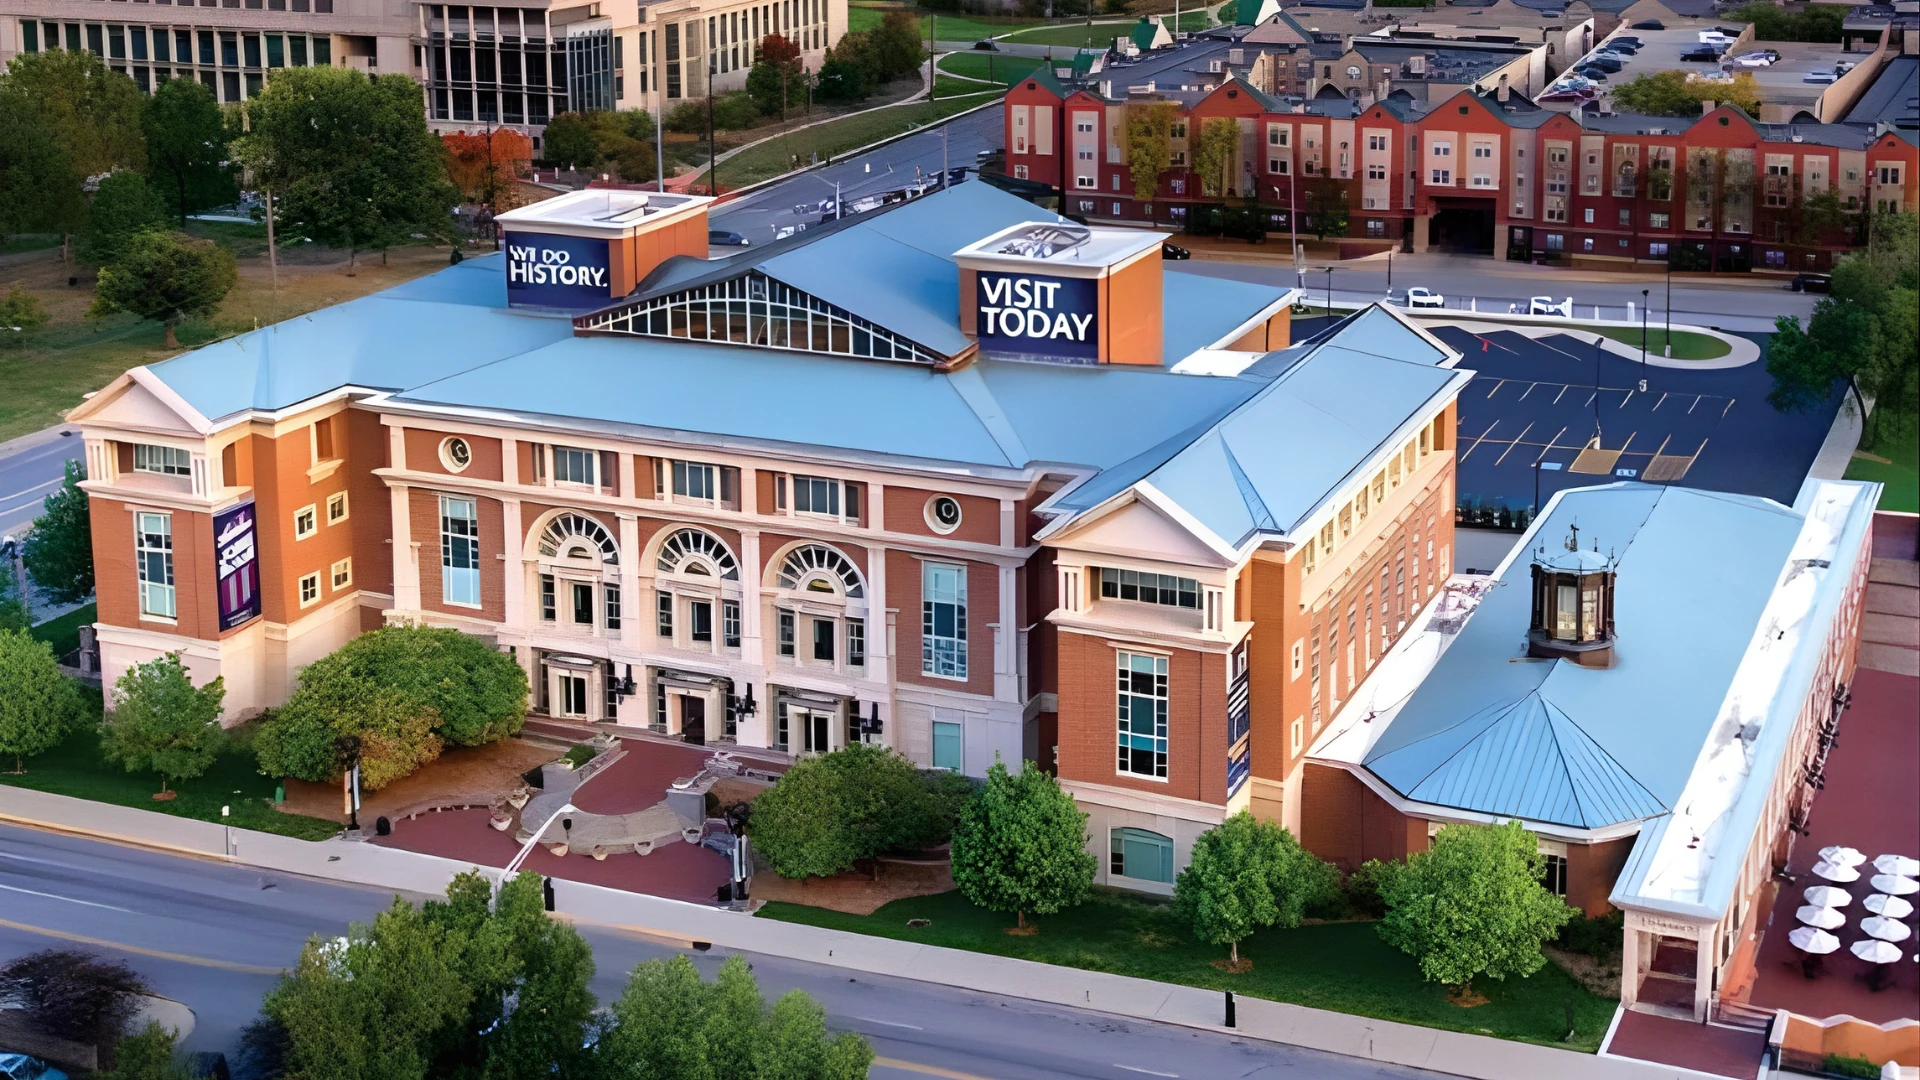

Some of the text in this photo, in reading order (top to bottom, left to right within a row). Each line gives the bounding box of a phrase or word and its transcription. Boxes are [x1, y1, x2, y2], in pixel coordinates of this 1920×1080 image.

[542, 249, 570, 264] DO
[510, 260, 608, 287] HISTORY.
[981, 277, 1062, 309] VISIT
[980, 306, 1093, 341] TODAY
